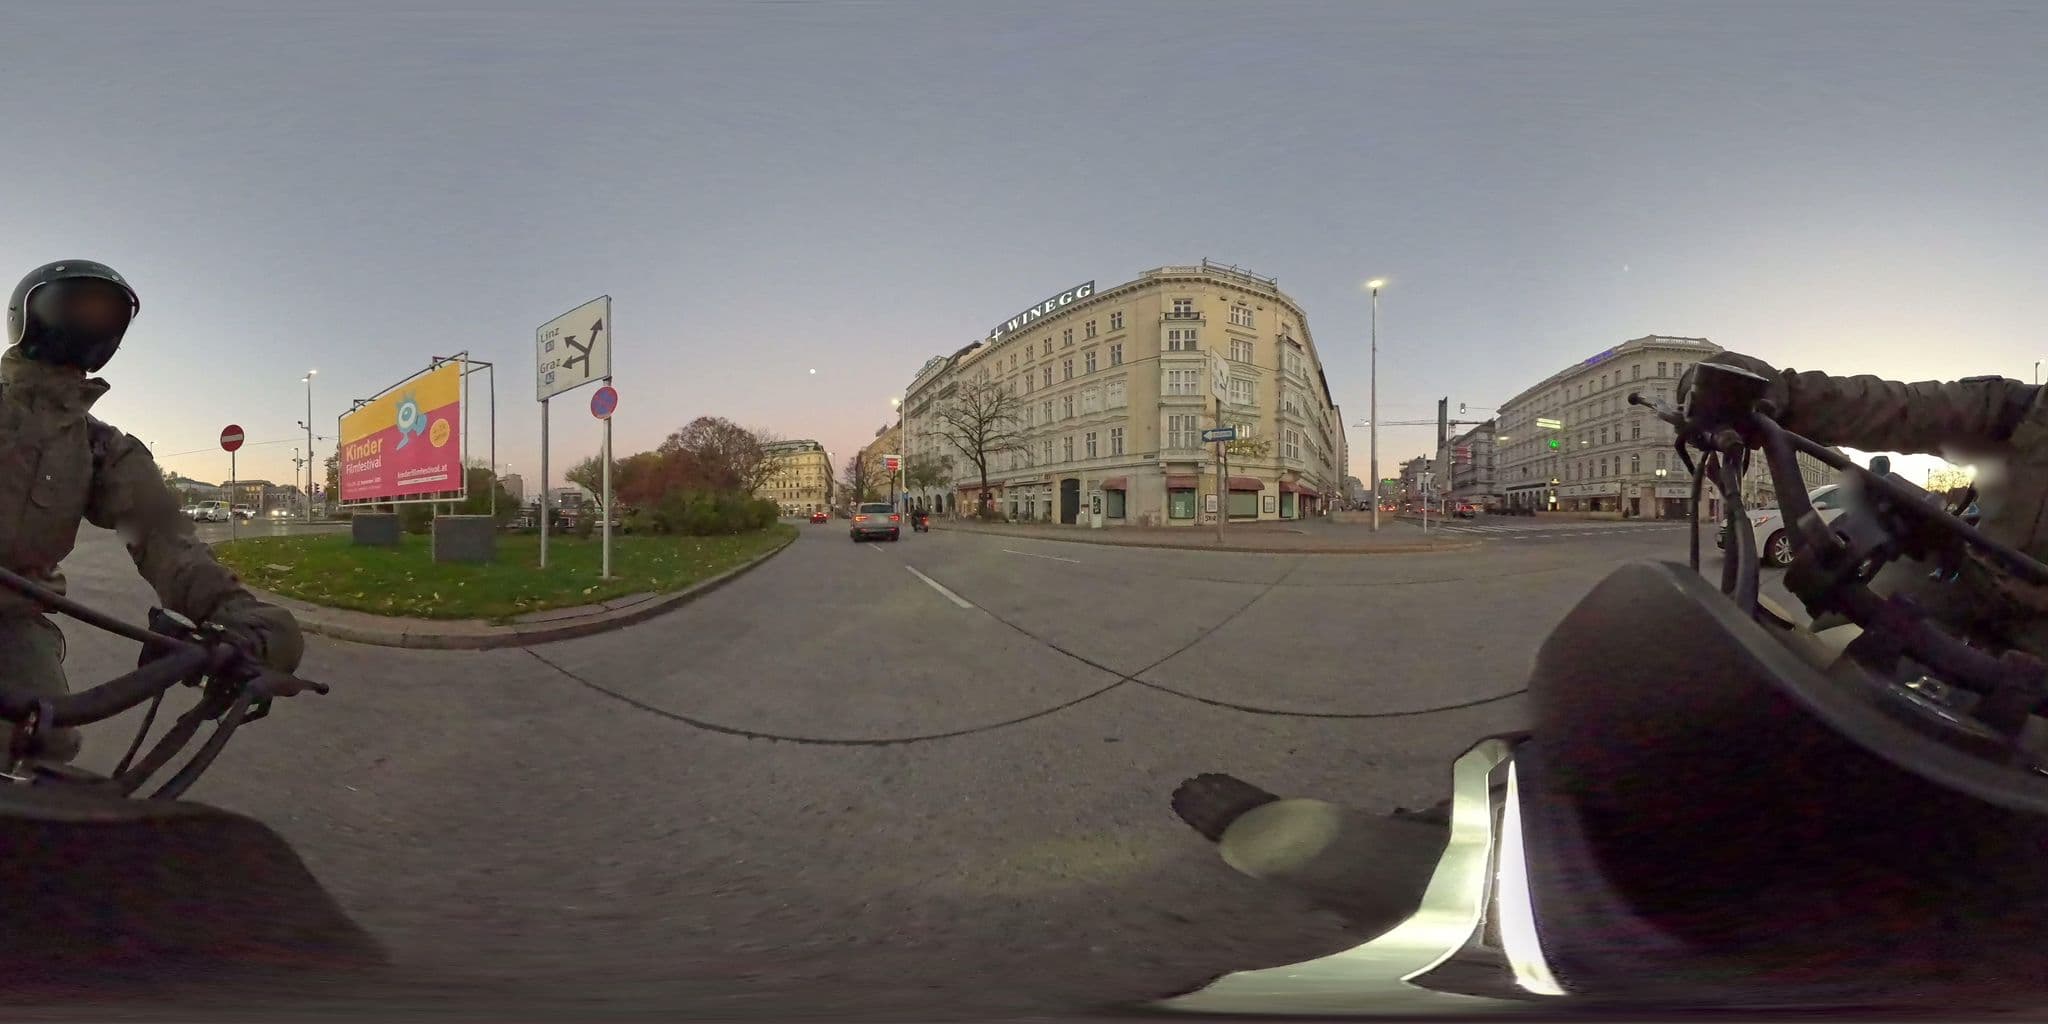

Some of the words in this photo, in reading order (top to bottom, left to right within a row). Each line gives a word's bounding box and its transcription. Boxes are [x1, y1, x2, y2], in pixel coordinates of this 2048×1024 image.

[1007, 284, 1092, 332] WINEGG
[540, 327, 560, 343] Linz
[540, 358, 561, 374] Graz
[346, 438, 384, 462] Kinder
[346, 455, 382, 475] Filmfestival
